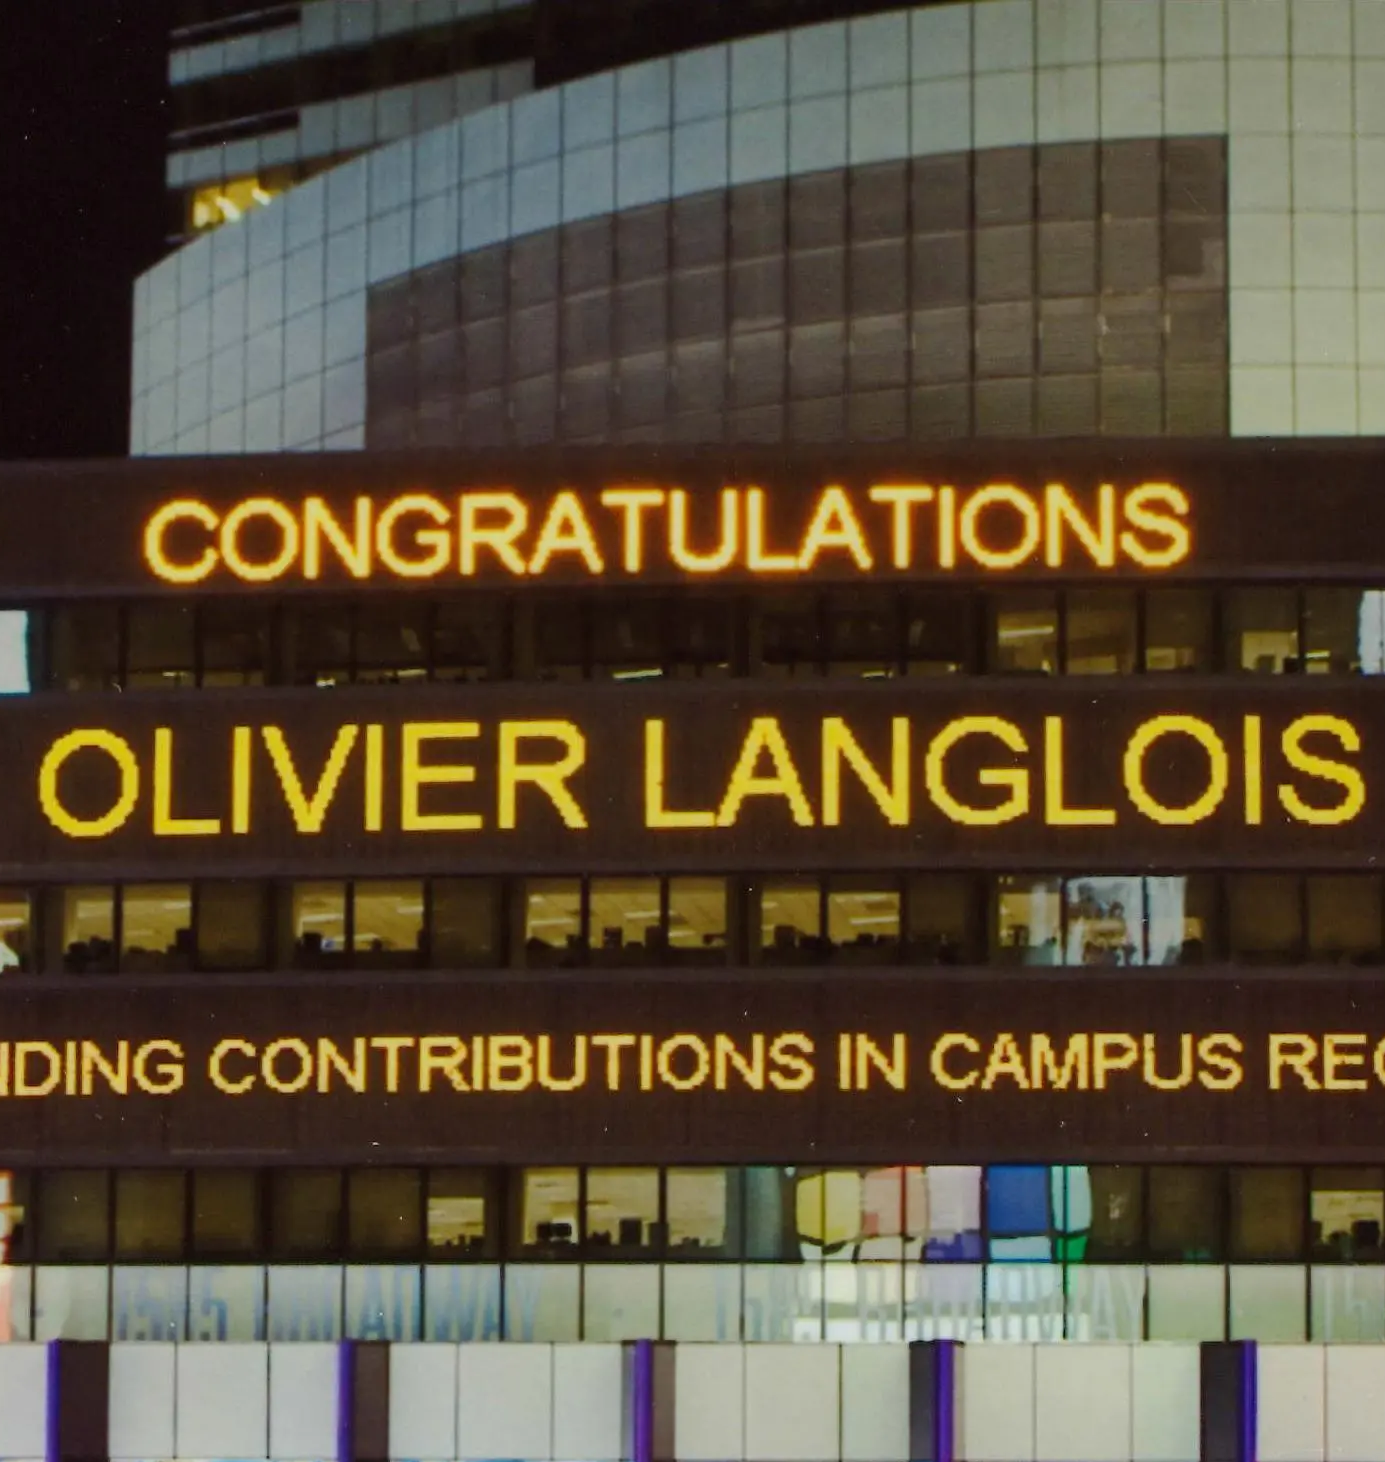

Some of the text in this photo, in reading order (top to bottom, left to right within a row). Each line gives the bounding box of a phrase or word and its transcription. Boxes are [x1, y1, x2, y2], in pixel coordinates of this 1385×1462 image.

[142, 480, 1192, 585] CONGRATULATIONS
[38, 713, 1368, 838] OLIVIER LANGLOIS
[209, 1033, 814, 1094] CONTRIBUTIONS
[839, 1033, 906, 1090] IN
[930, 1034, 1243, 1090] CAMPUS
